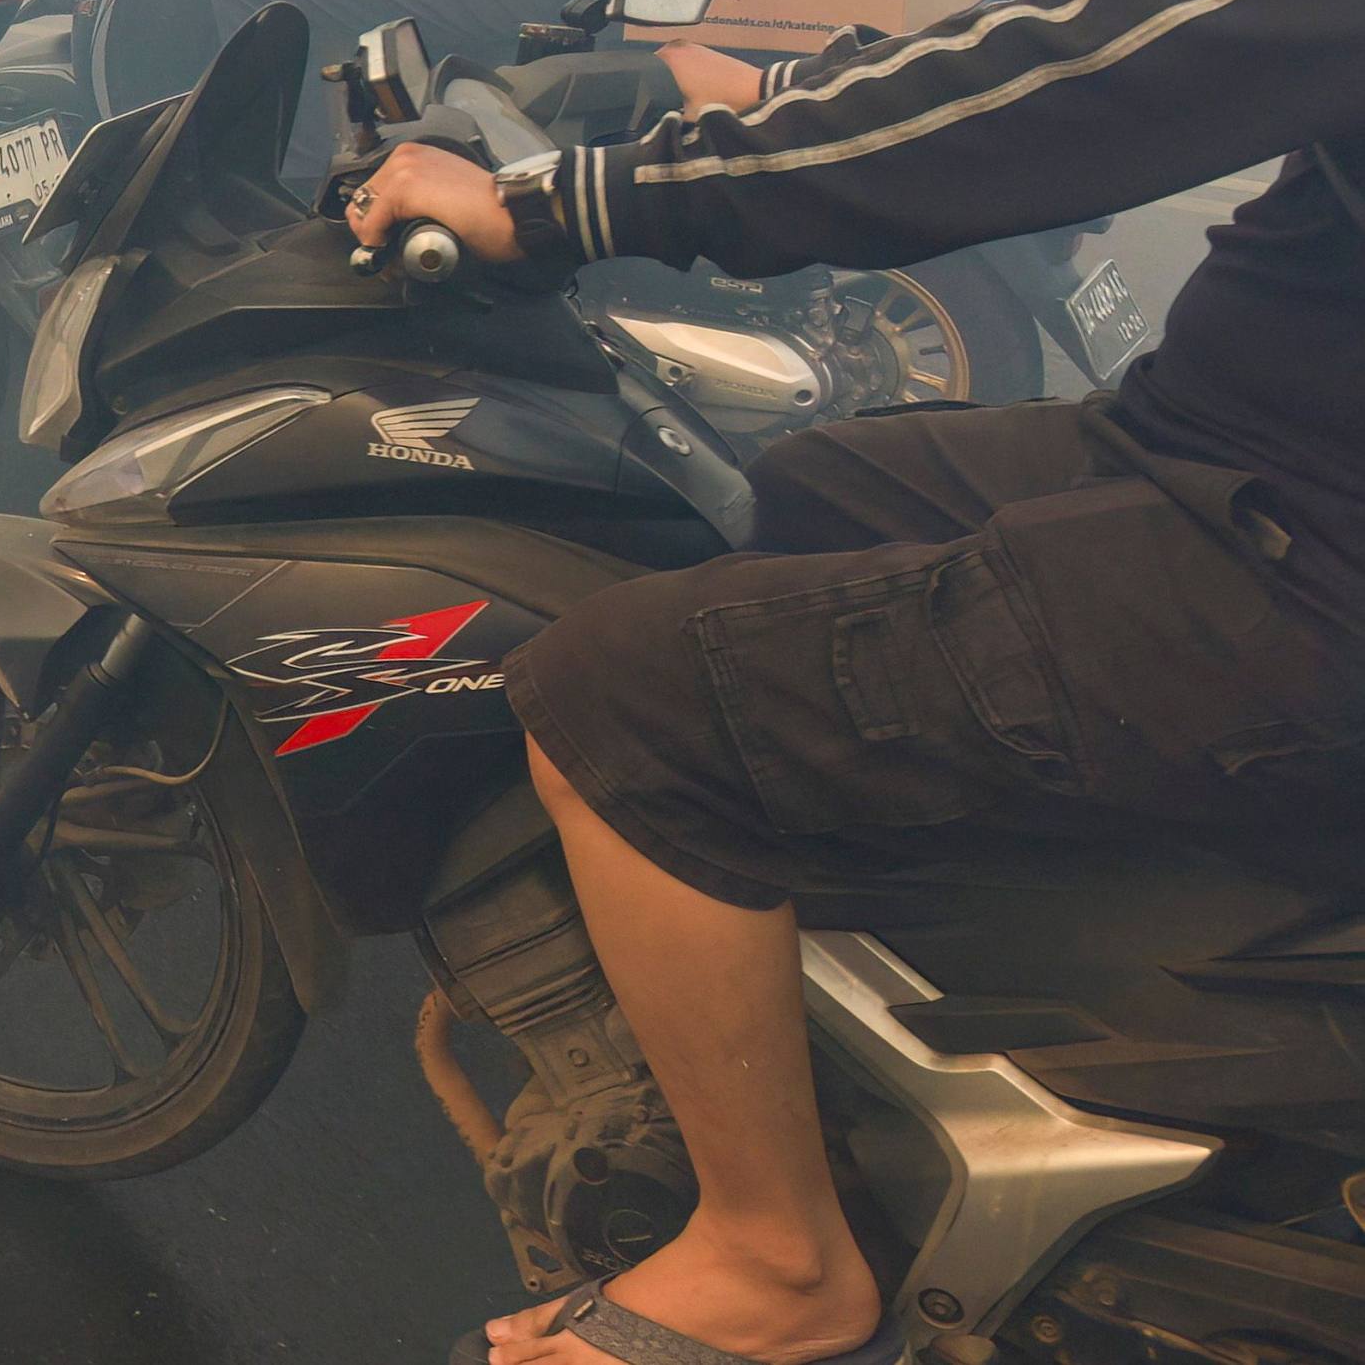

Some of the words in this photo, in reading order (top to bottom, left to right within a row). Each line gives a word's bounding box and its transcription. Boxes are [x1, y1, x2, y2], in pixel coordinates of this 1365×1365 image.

[0, 136, 37, 178] 4077
[40, 128, 63, 161] PR
[367, 442, 475, 470] HONDA
